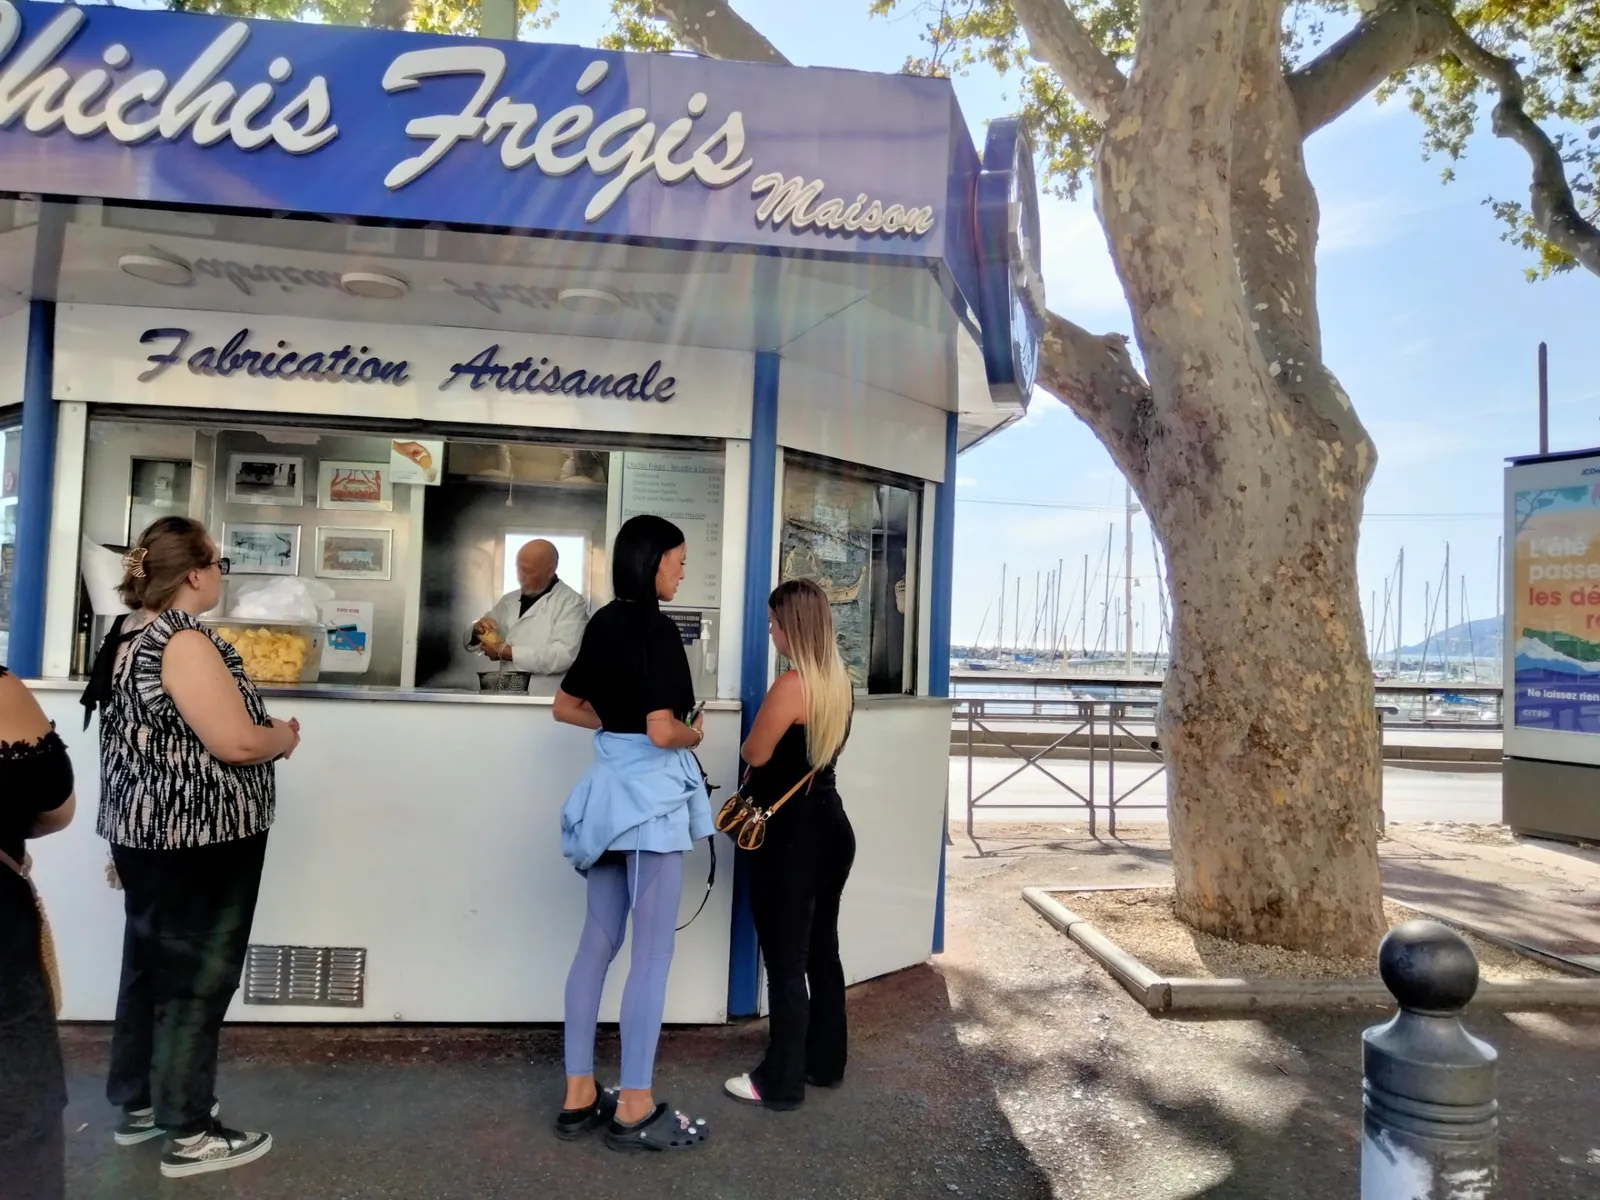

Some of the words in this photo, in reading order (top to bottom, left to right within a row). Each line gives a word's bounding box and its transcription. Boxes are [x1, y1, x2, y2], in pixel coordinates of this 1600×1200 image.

[381, 45, 753, 223] Frégis
[751, 172, 935, 237] Maison
[138, 327, 411, 386] Fabrication
[438, 343, 677, 404] Artisanale
[1530, 535, 1586, 558] L'été
[1529, 587, 1562, 606] les
[1527, 688, 1541, 698] Ne
[1543, 689, 1577, 700] laissez
[1579, 691, 1600, 702] rien
